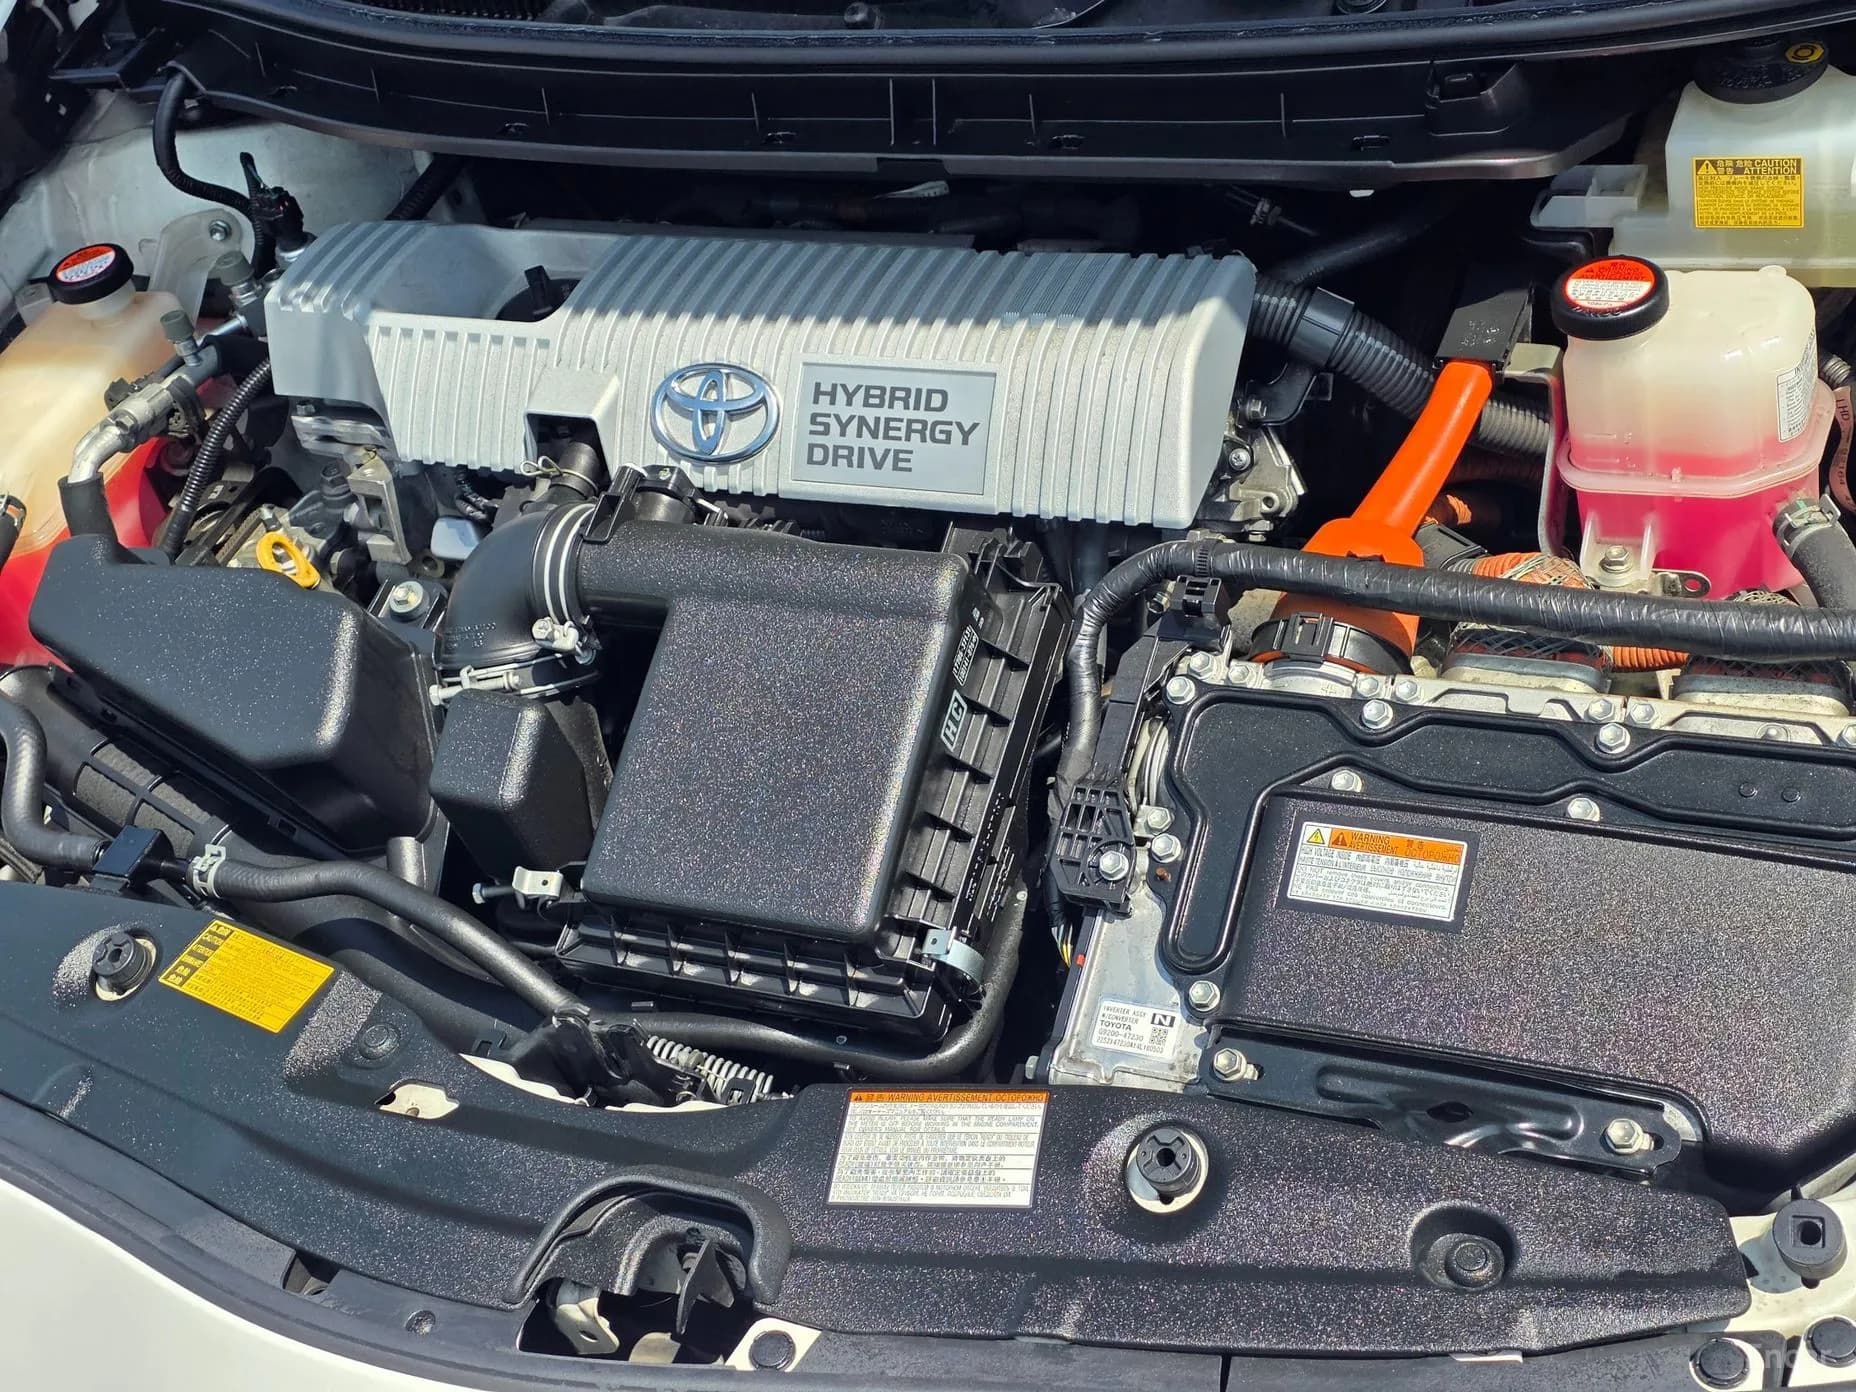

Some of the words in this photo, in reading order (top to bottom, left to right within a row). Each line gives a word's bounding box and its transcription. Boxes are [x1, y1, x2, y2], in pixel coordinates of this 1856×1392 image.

[812, 382, 949, 413] HYBRID
[809, 412, 980, 446] SYNERGY
[806, 443, 914, 473] DRIVE
[1347, 840, 1398, 855] AVERTISSEMENT
[1349, 832, 1390, 844] WARNING
[1099, 1019, 1132, 1030] TOYOTA
